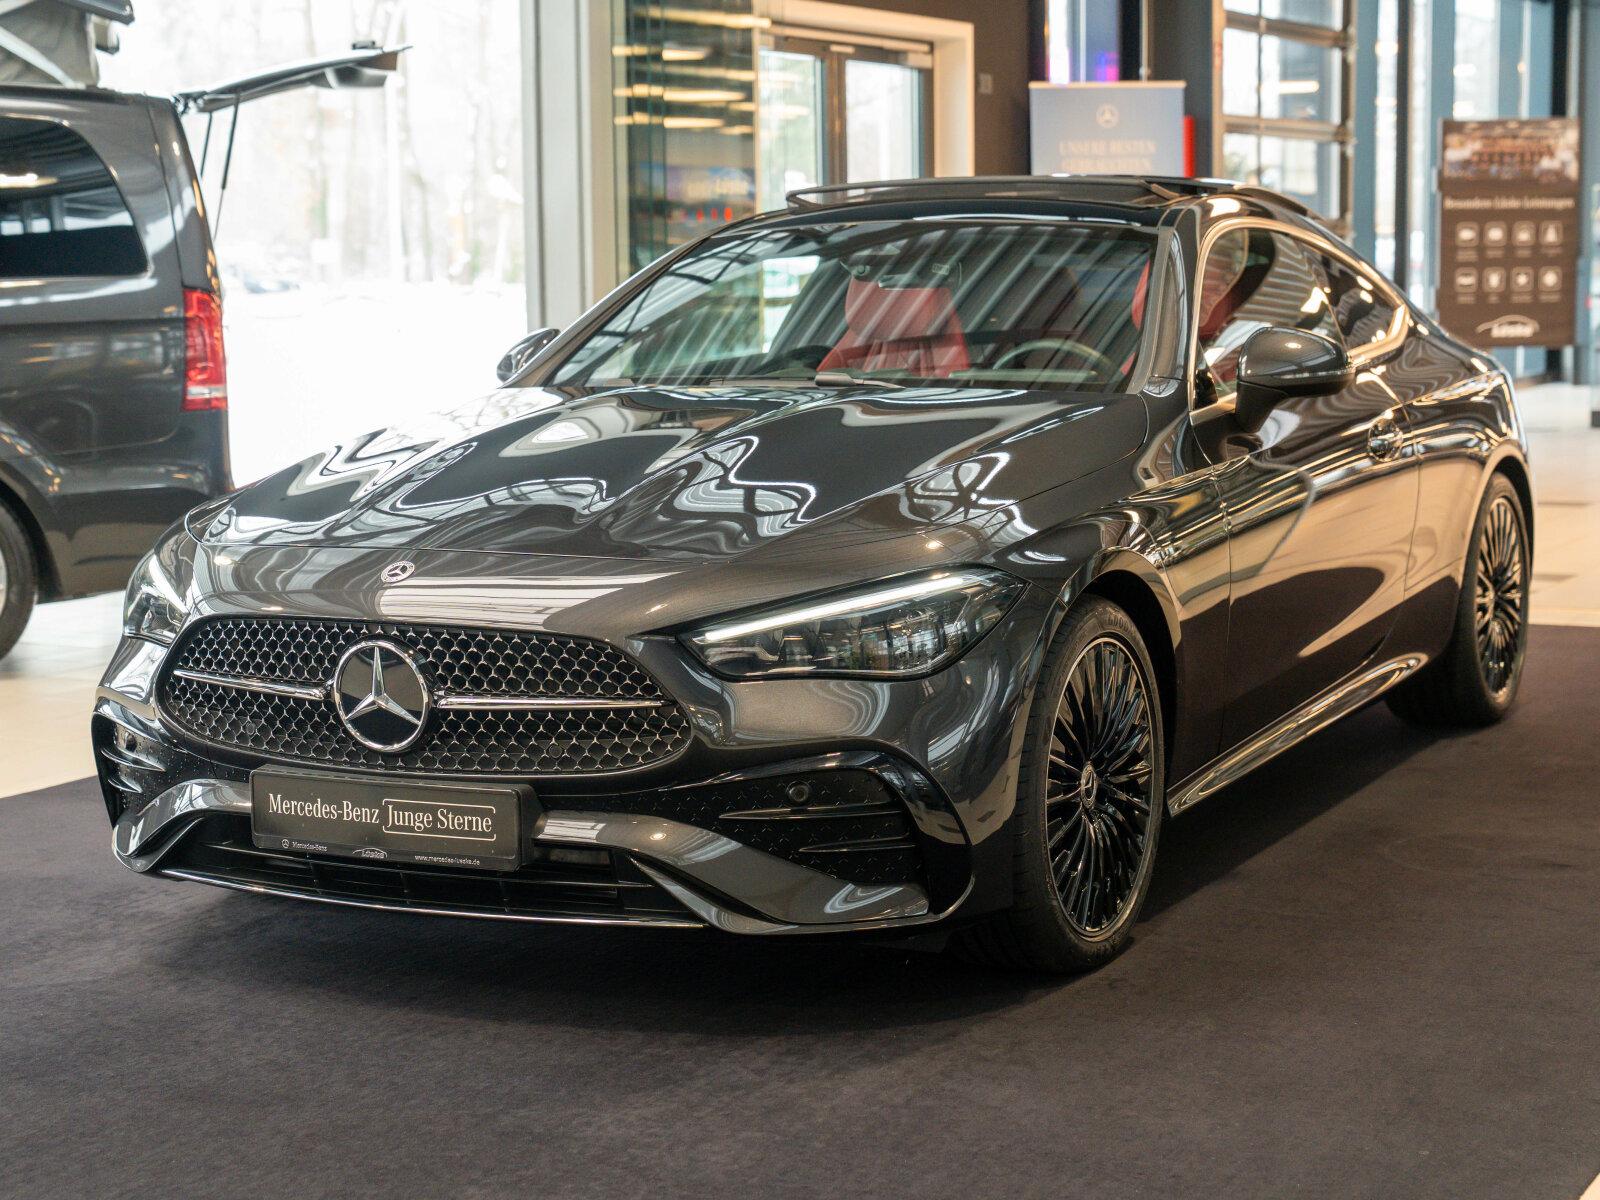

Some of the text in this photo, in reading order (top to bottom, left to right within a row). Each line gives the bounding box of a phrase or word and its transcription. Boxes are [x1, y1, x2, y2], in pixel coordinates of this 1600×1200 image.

[268, 793, 492, 832] Mercedes-Benz Junge Sterne
